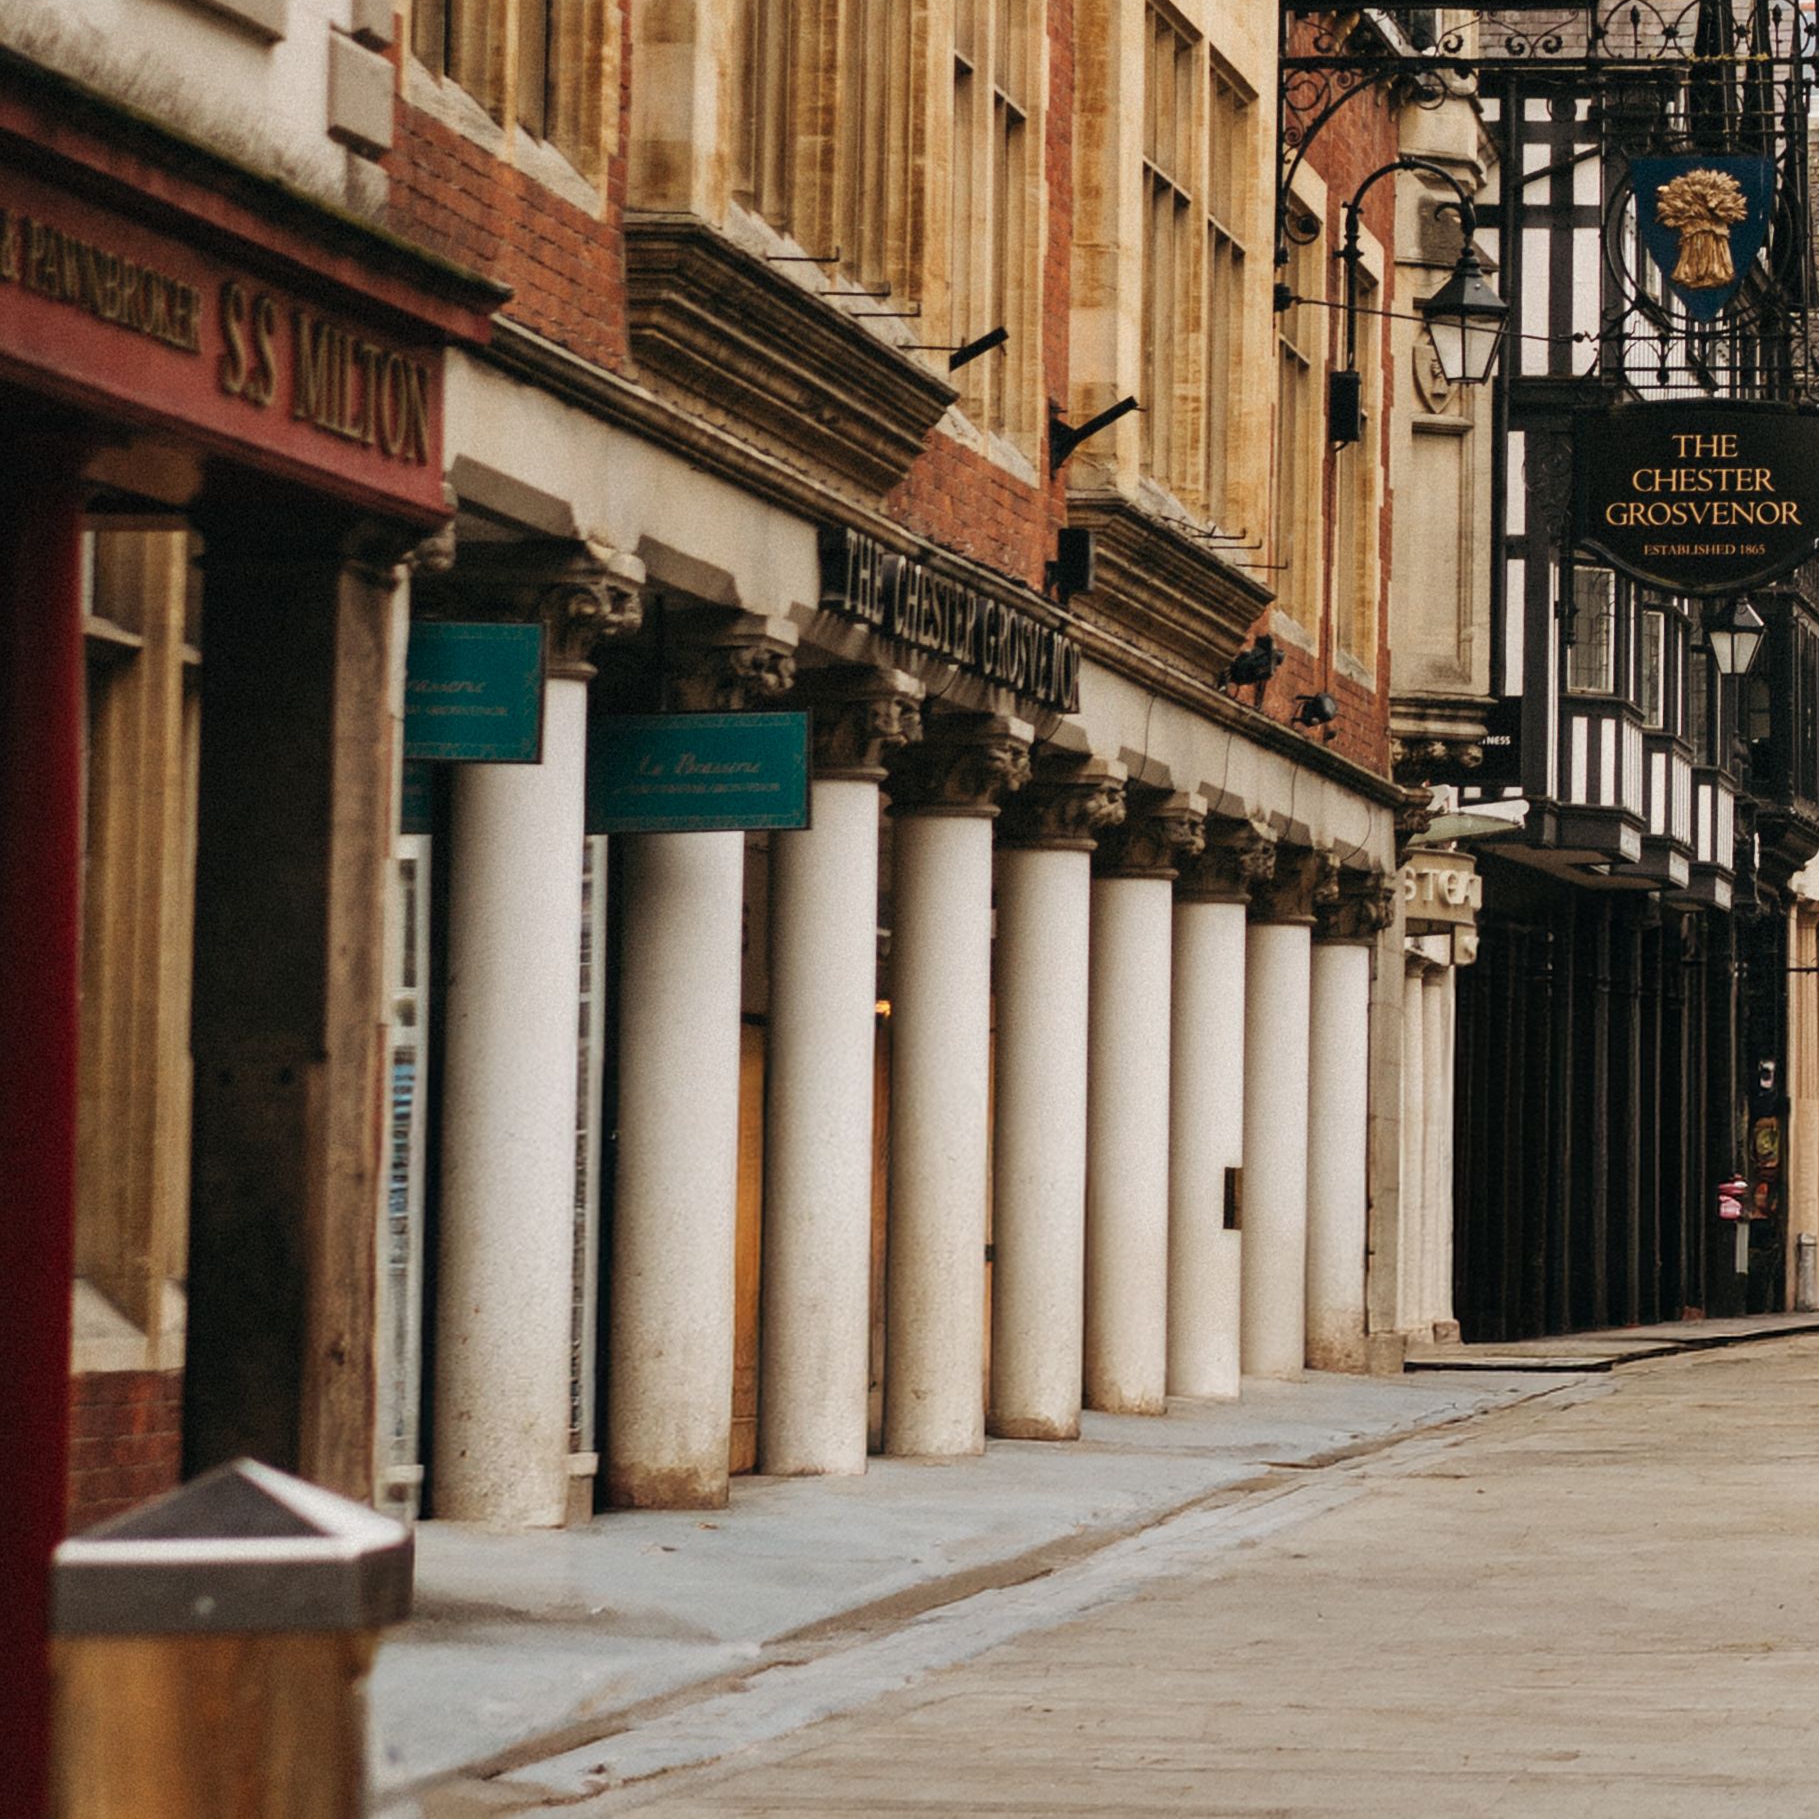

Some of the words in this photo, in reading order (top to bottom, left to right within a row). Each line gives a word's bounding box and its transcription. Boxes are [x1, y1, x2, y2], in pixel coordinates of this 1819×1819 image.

[292, 304, 430, 467] MILTON
[1671, 434, 1739, 459] THE
[1631, 468, 1776, 493] CHESTER
[1605, 501, 1803, 526] GROSVENOR
[1643, 543, 1737, 556] ESTABLISHED
[1739, 543, 1767, 556] 1865
[844, 526, 884, 626] THE
[894, 554, 977, 666] CHESTER
[983, 598, 1081, 714] GROSVENOR
